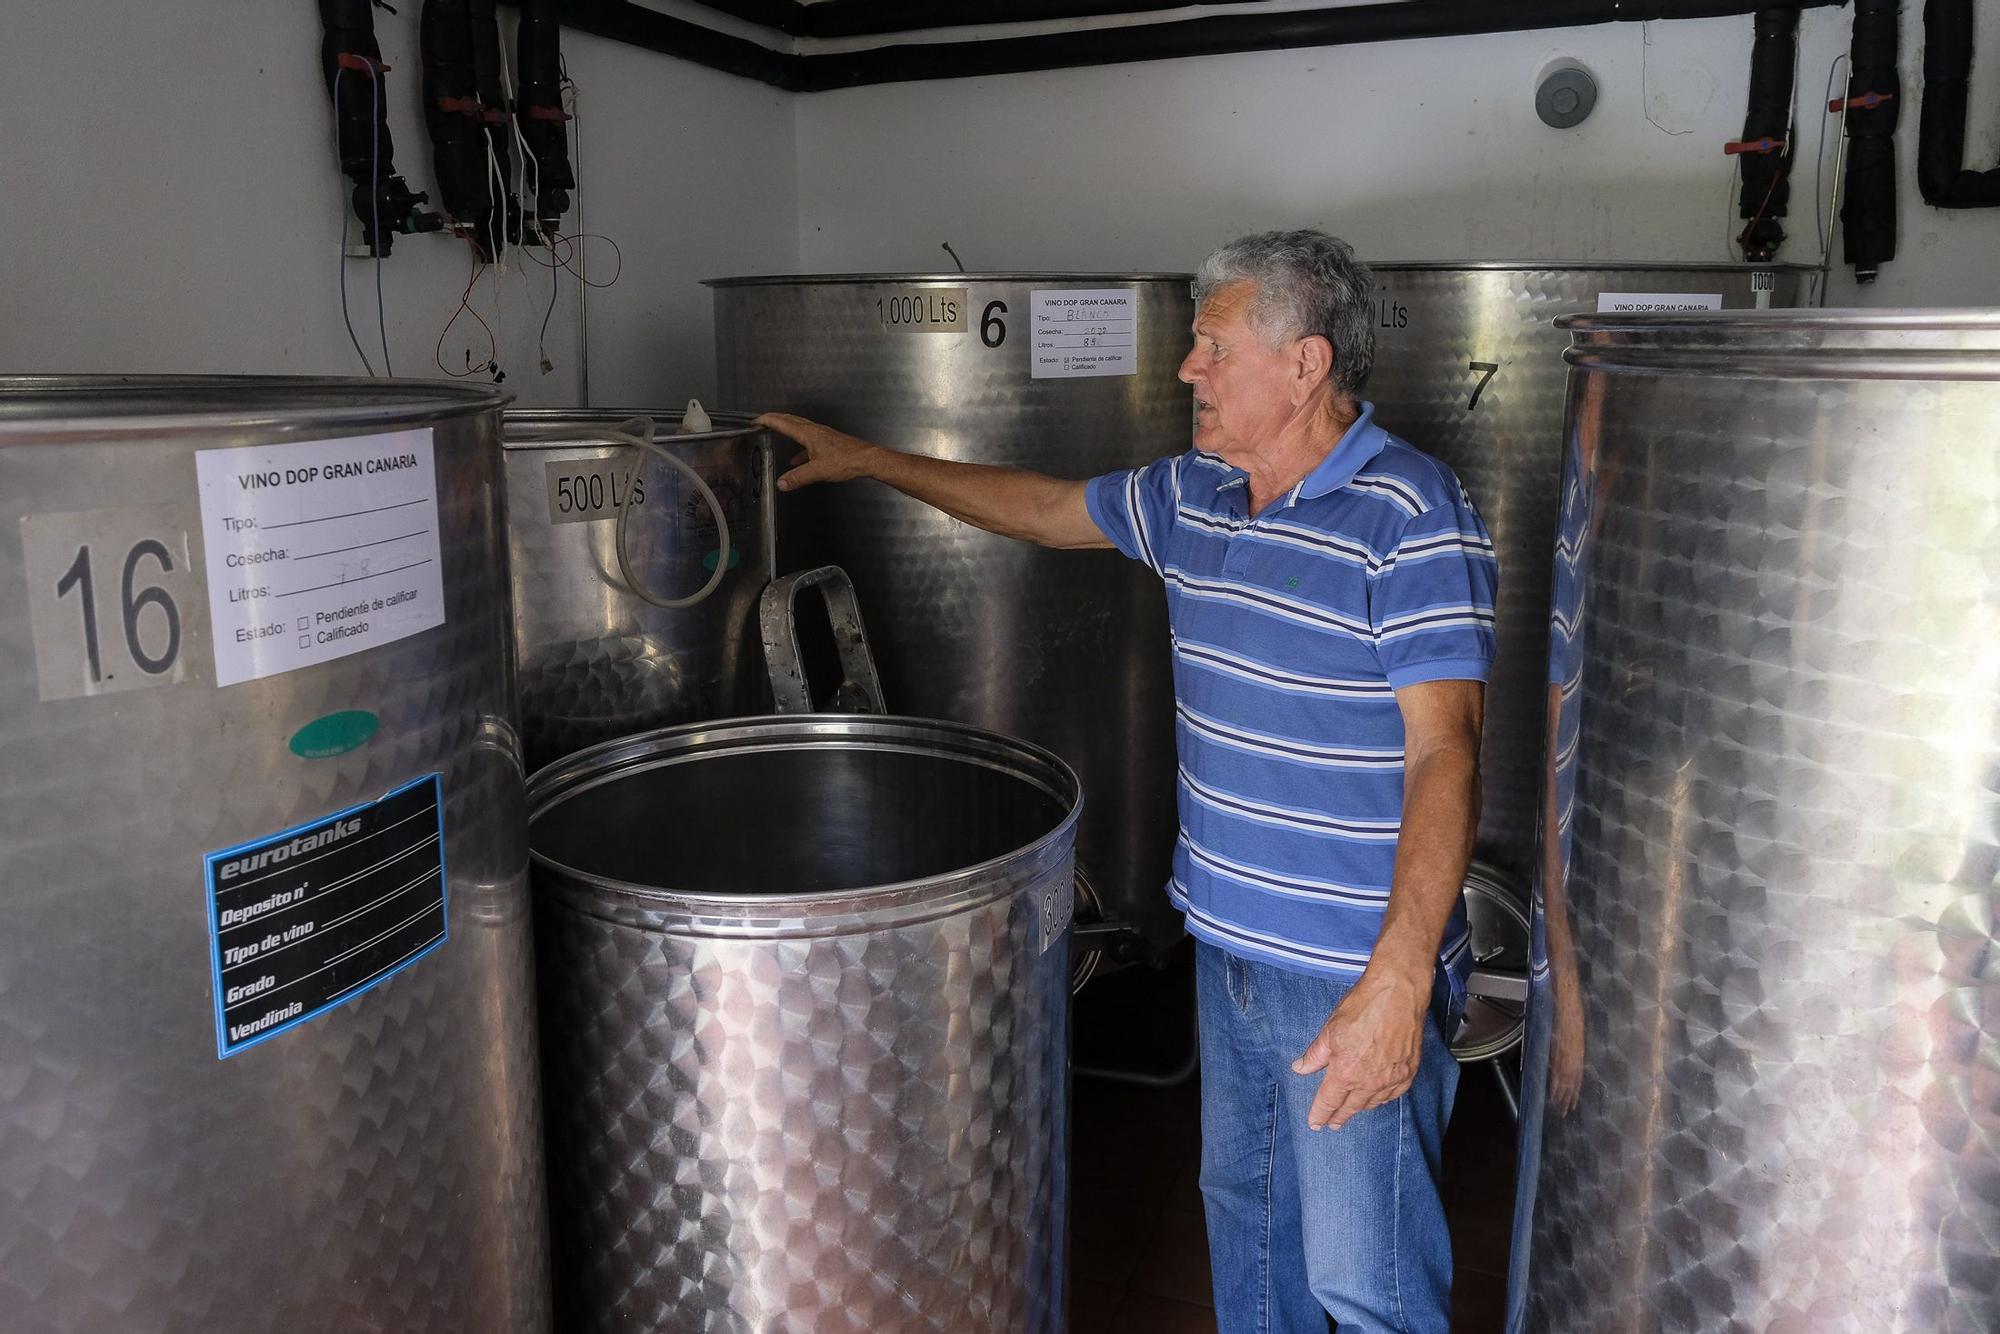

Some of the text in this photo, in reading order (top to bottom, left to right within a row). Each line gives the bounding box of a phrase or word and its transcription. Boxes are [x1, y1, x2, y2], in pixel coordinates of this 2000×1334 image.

[877, 296, 957, 325] 1.000 Lts
[1100, 298, 1127, 306] CANARIA
[1381, 298, 1408, 328] Lts
[1678, 304, 1709, 312] CANARIA
[980, 300, 1008, 348] 6
[1469, 361, 1499, 411] 7
[238, 453, 418, 490] VINO DOP GRAN CANARIA
[558, 474, 604, 514] 500
[223, 516, 258, 533] Tipo:
[226, 547, 289, 568] Cosecha:
[229, 584, 270, 603] Litros:
[316, 589, 418, 625] Pendiente de calificar
[57, 539, 181, 683] 16
[236, 622, 286, 643] Estado:
[317, 621, 369, 645] Calificado
[220, 817, 362, 880] eurotanks
[221, 893, 292, 927] Deposito
[224, 920, 314, 965] Tipo de vino
[227, 974, 275, 1003] Grado
[230, 1001, 303, 1042] Vendimia
